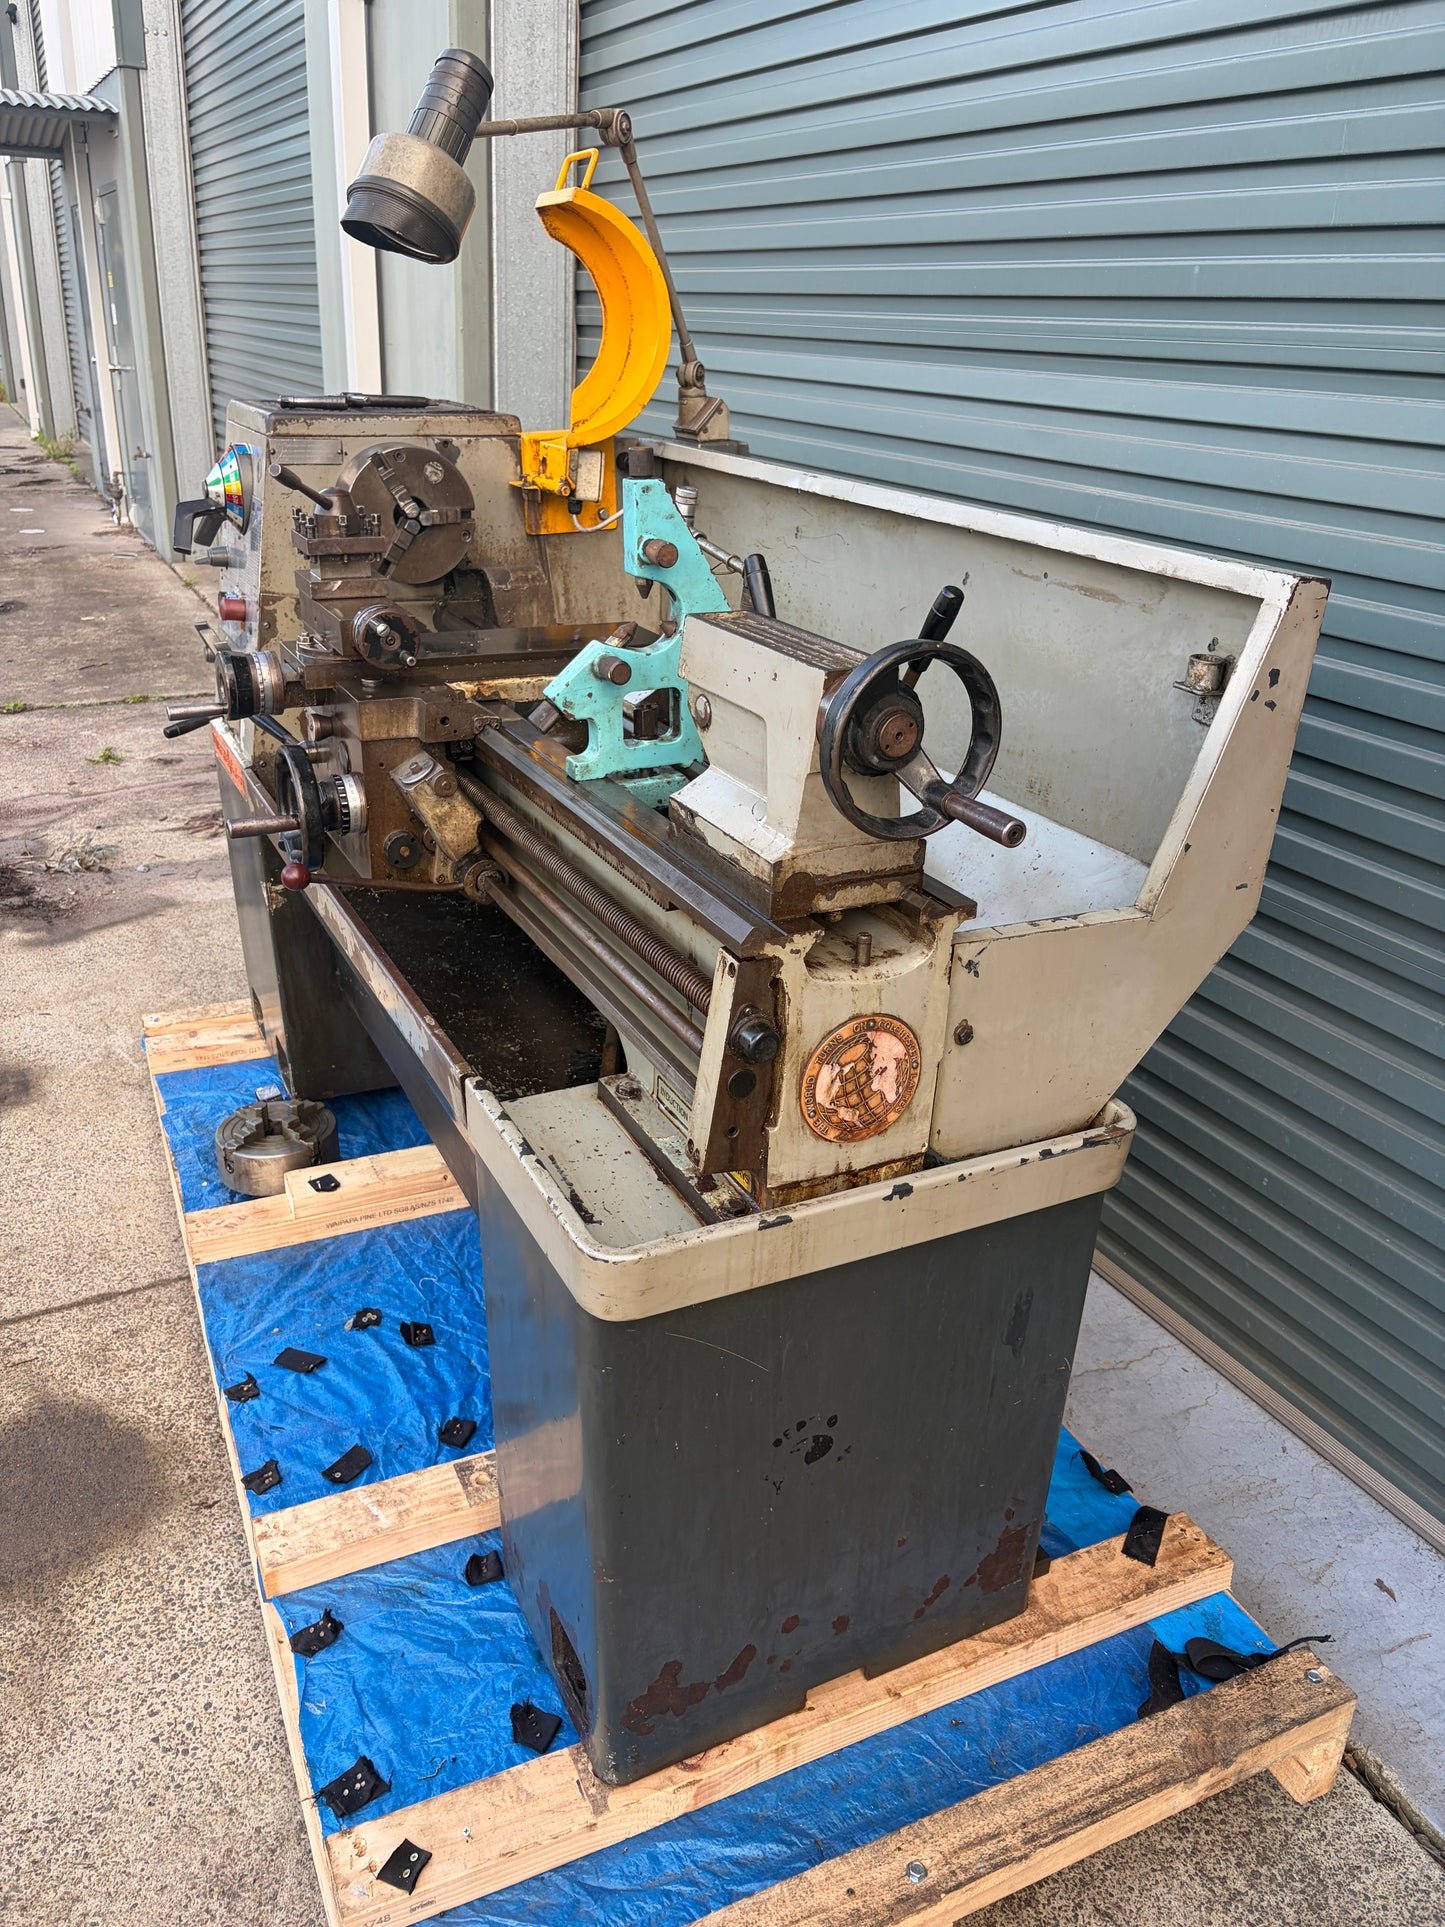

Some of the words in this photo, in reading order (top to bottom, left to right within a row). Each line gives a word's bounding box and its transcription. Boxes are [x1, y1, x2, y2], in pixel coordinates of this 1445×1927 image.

[853, 1021, 867, 1033] ON
[815, 1034, 844, 1064] TURNS
[804, 1076, 817, 1115] WORLD
[895, 1072, 918, 1115] LATHES
[813, 1117, 829, 1135] THE
[359, 1212, 377, 1222] PINE
[378, 1209, 393, 1218] LTD
[437, 1196, 454, 1205] 1748
